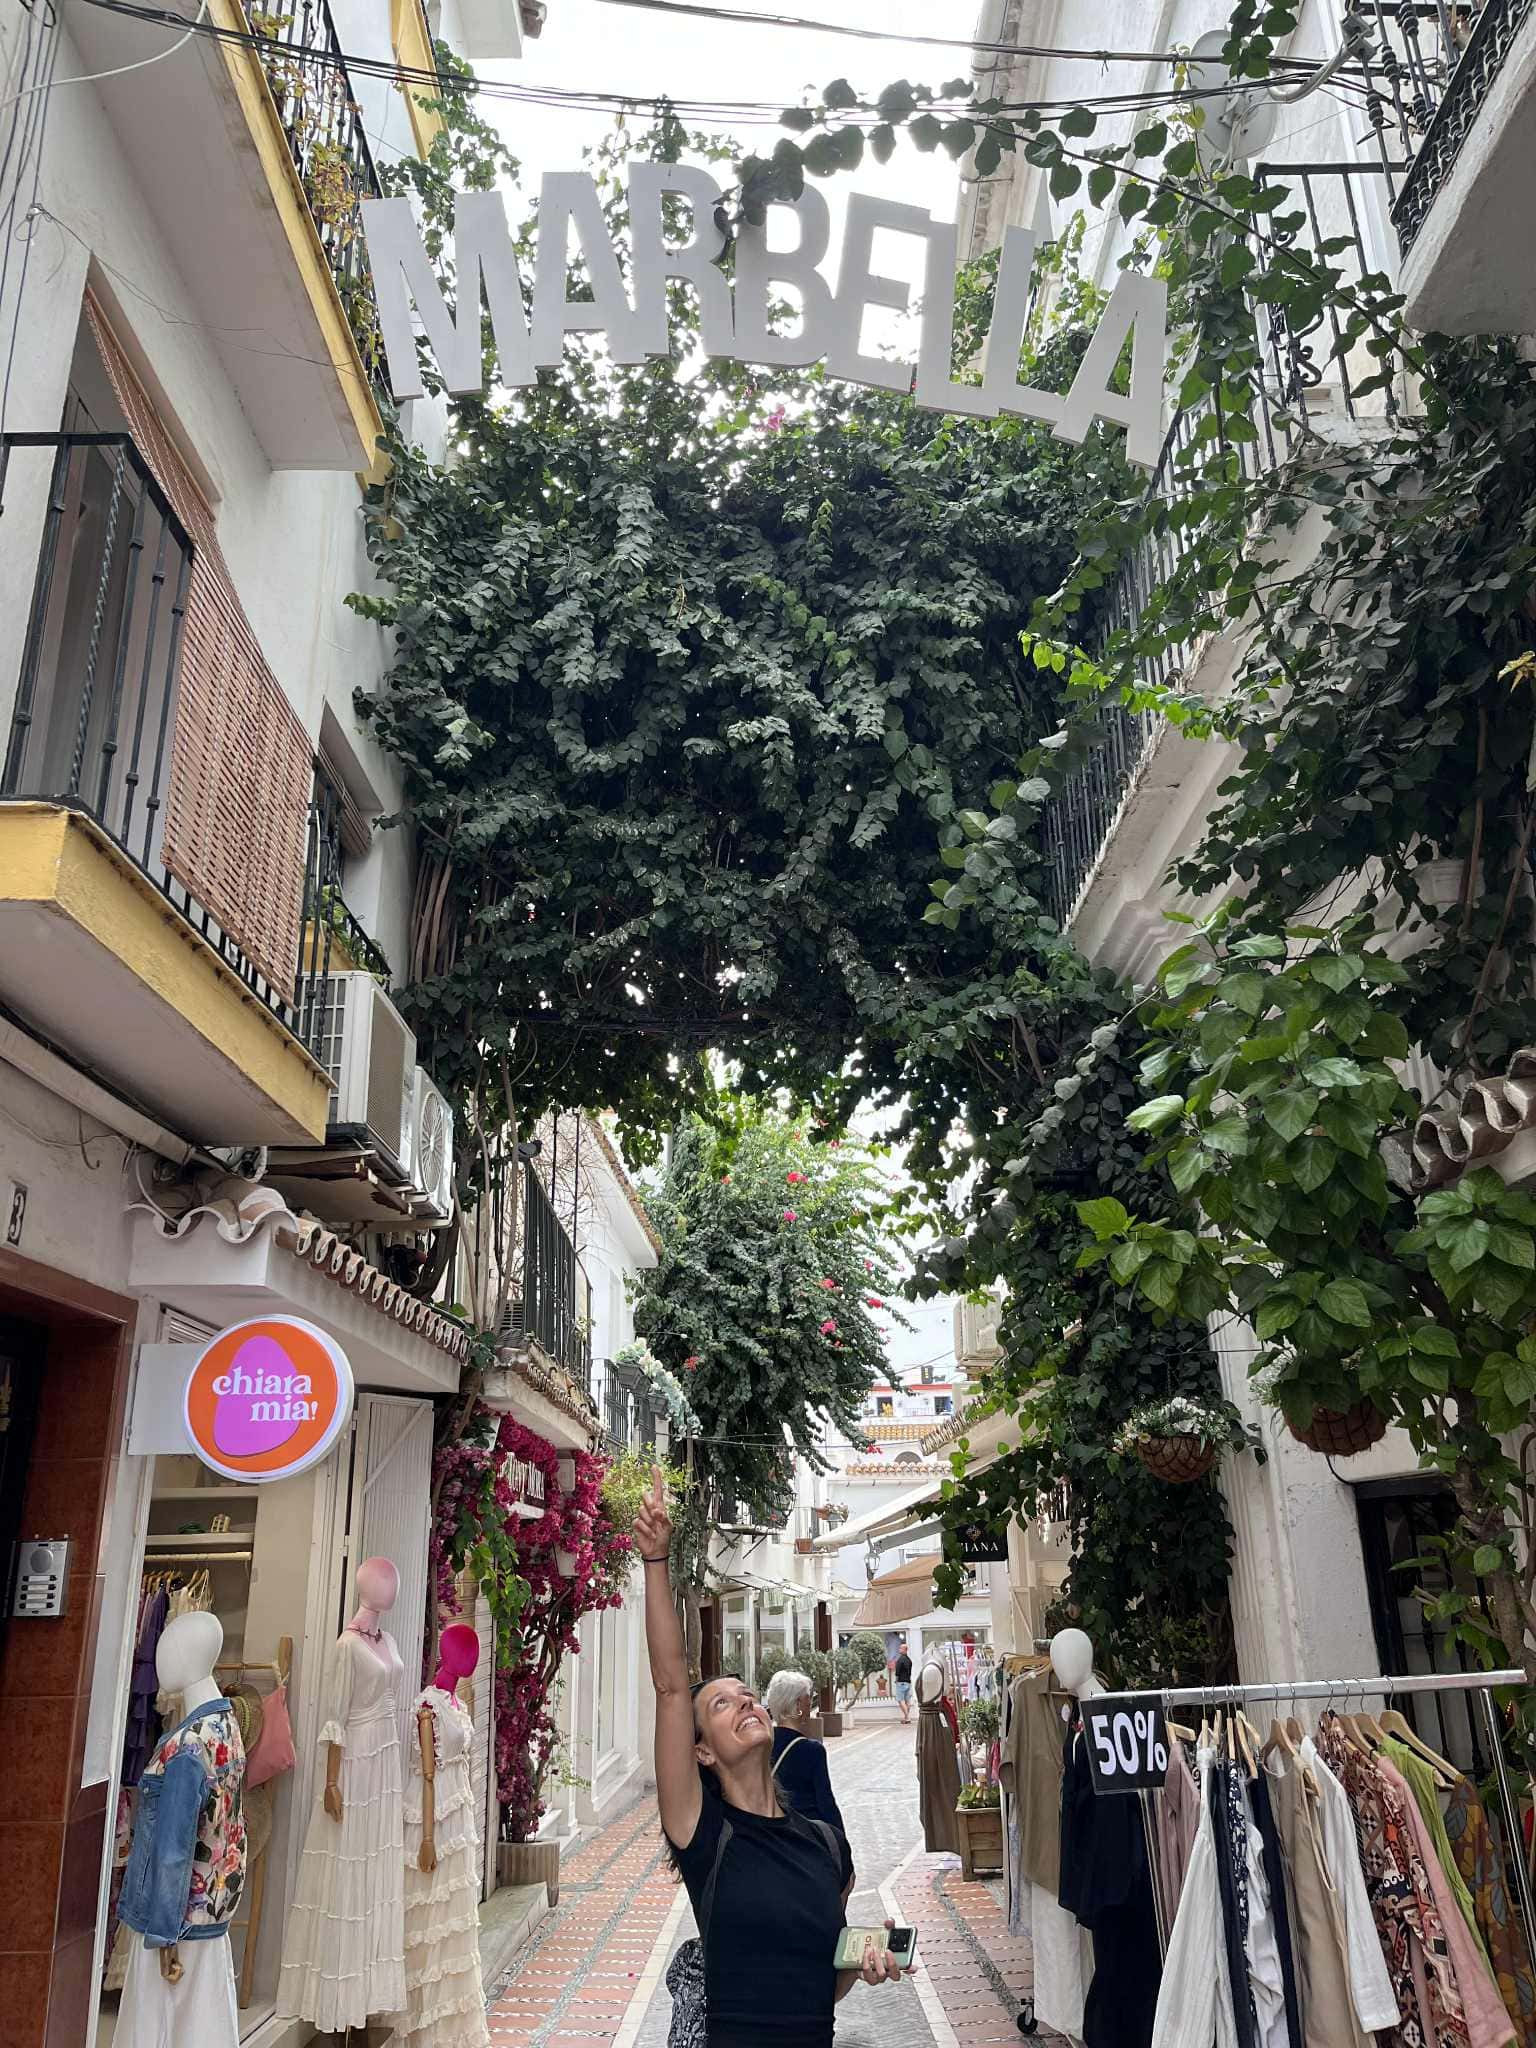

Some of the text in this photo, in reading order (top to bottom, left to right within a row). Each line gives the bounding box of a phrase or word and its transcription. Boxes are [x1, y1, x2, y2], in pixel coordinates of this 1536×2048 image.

[361, 161, 1168, 470] MARBELLA
[10, 1193, 24, 1240] 3
[211, 1365, 313, 1396] chiara
[249, 1394, 319, 1422] mia!
[960, 1541, 999, 1553] IANA
[1091, 1710, 1168, 1776] 50%
